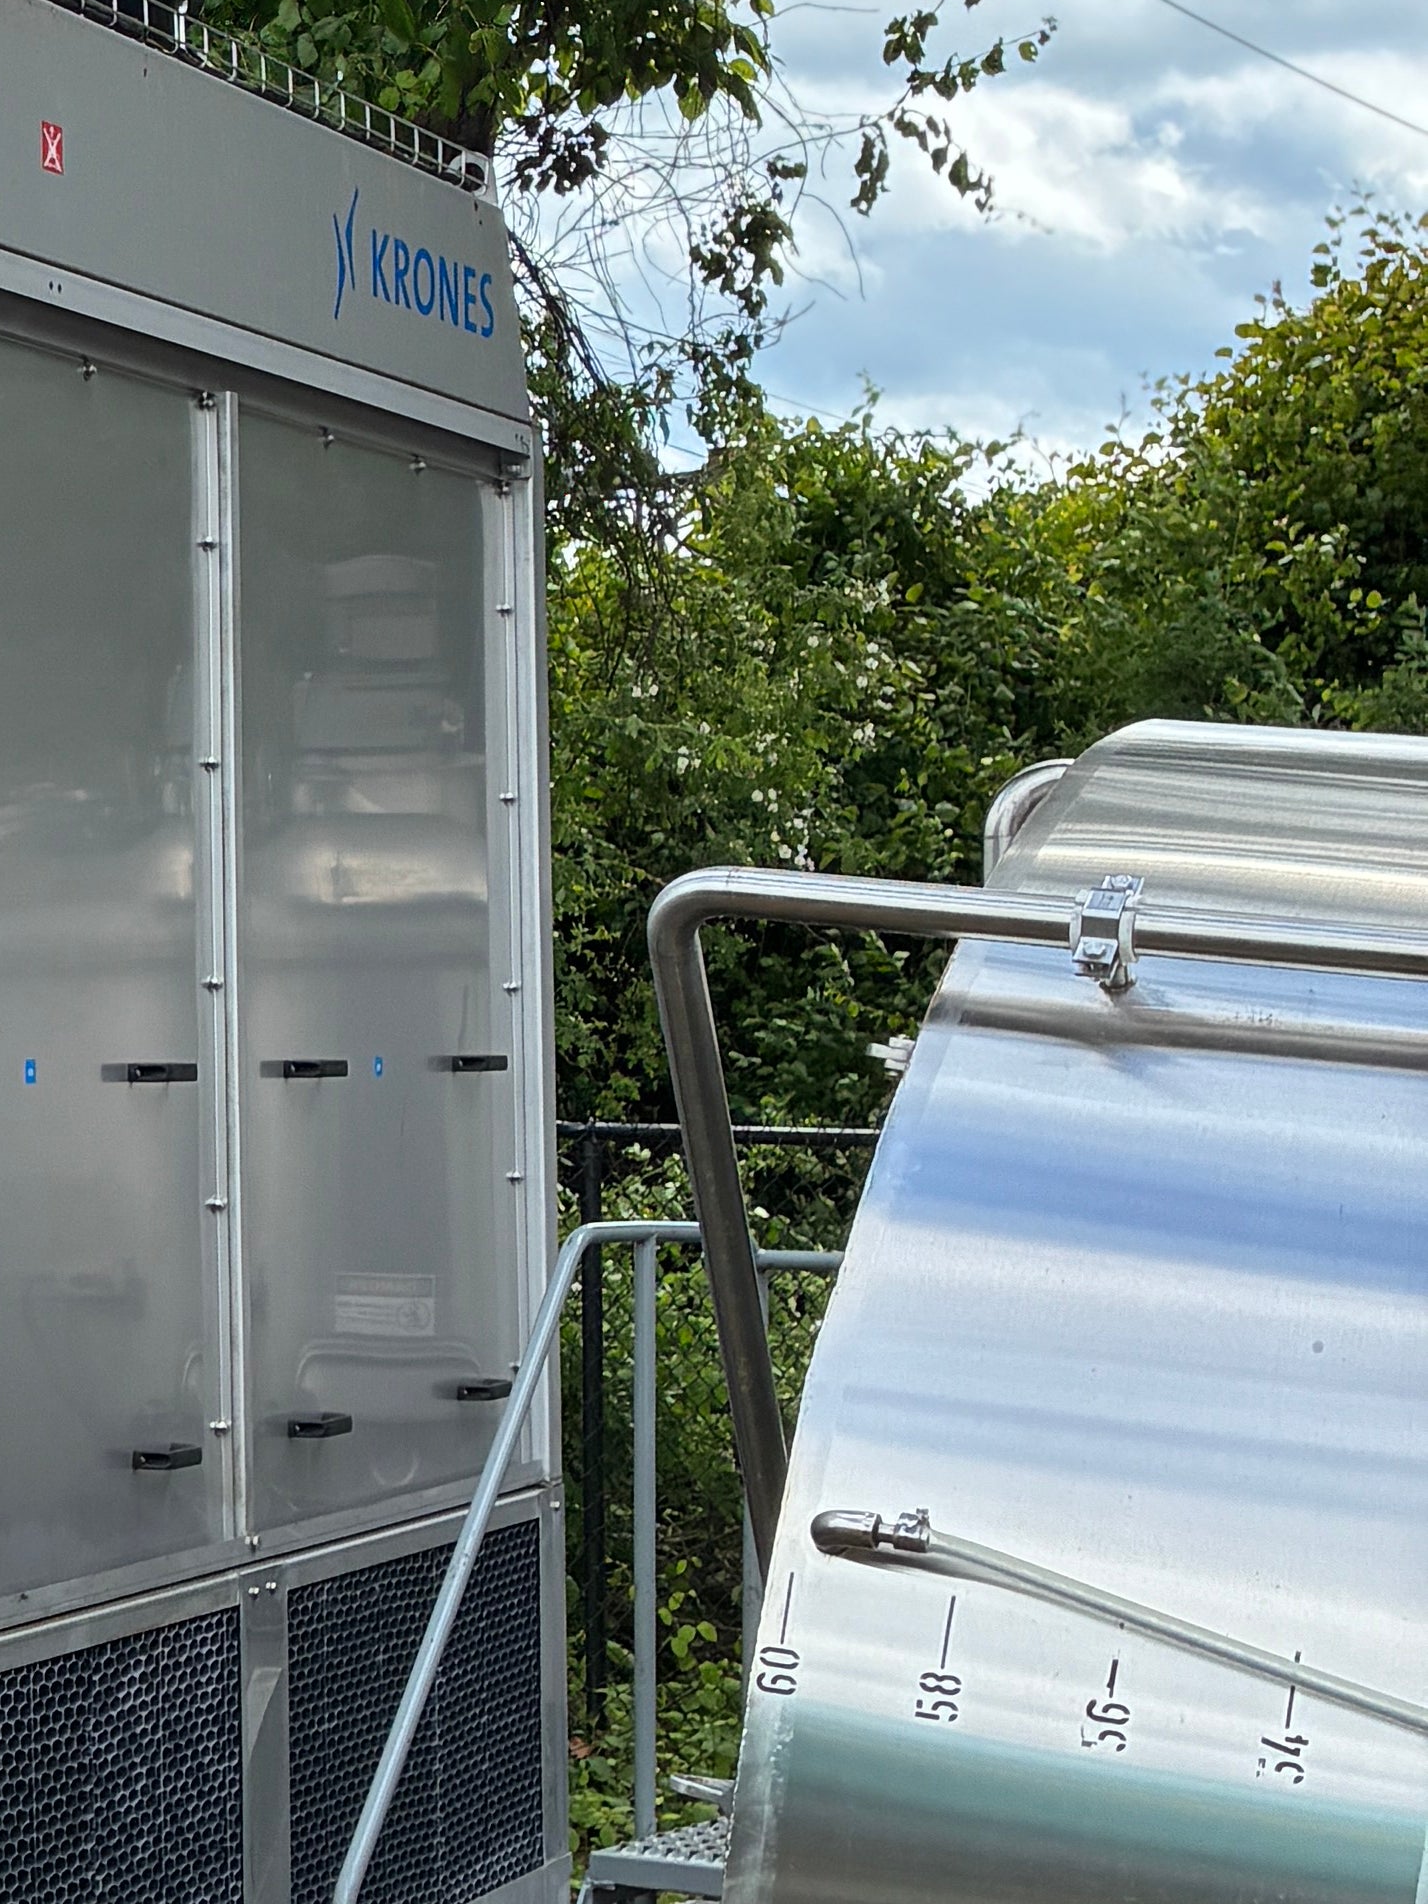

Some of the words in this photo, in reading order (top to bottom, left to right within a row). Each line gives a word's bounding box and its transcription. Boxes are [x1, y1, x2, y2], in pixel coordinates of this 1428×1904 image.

[370, 227, 495, 339] KRONES
[755, 1646, 801, 1696] 60
[914, 1671, 962, 1723] 58
